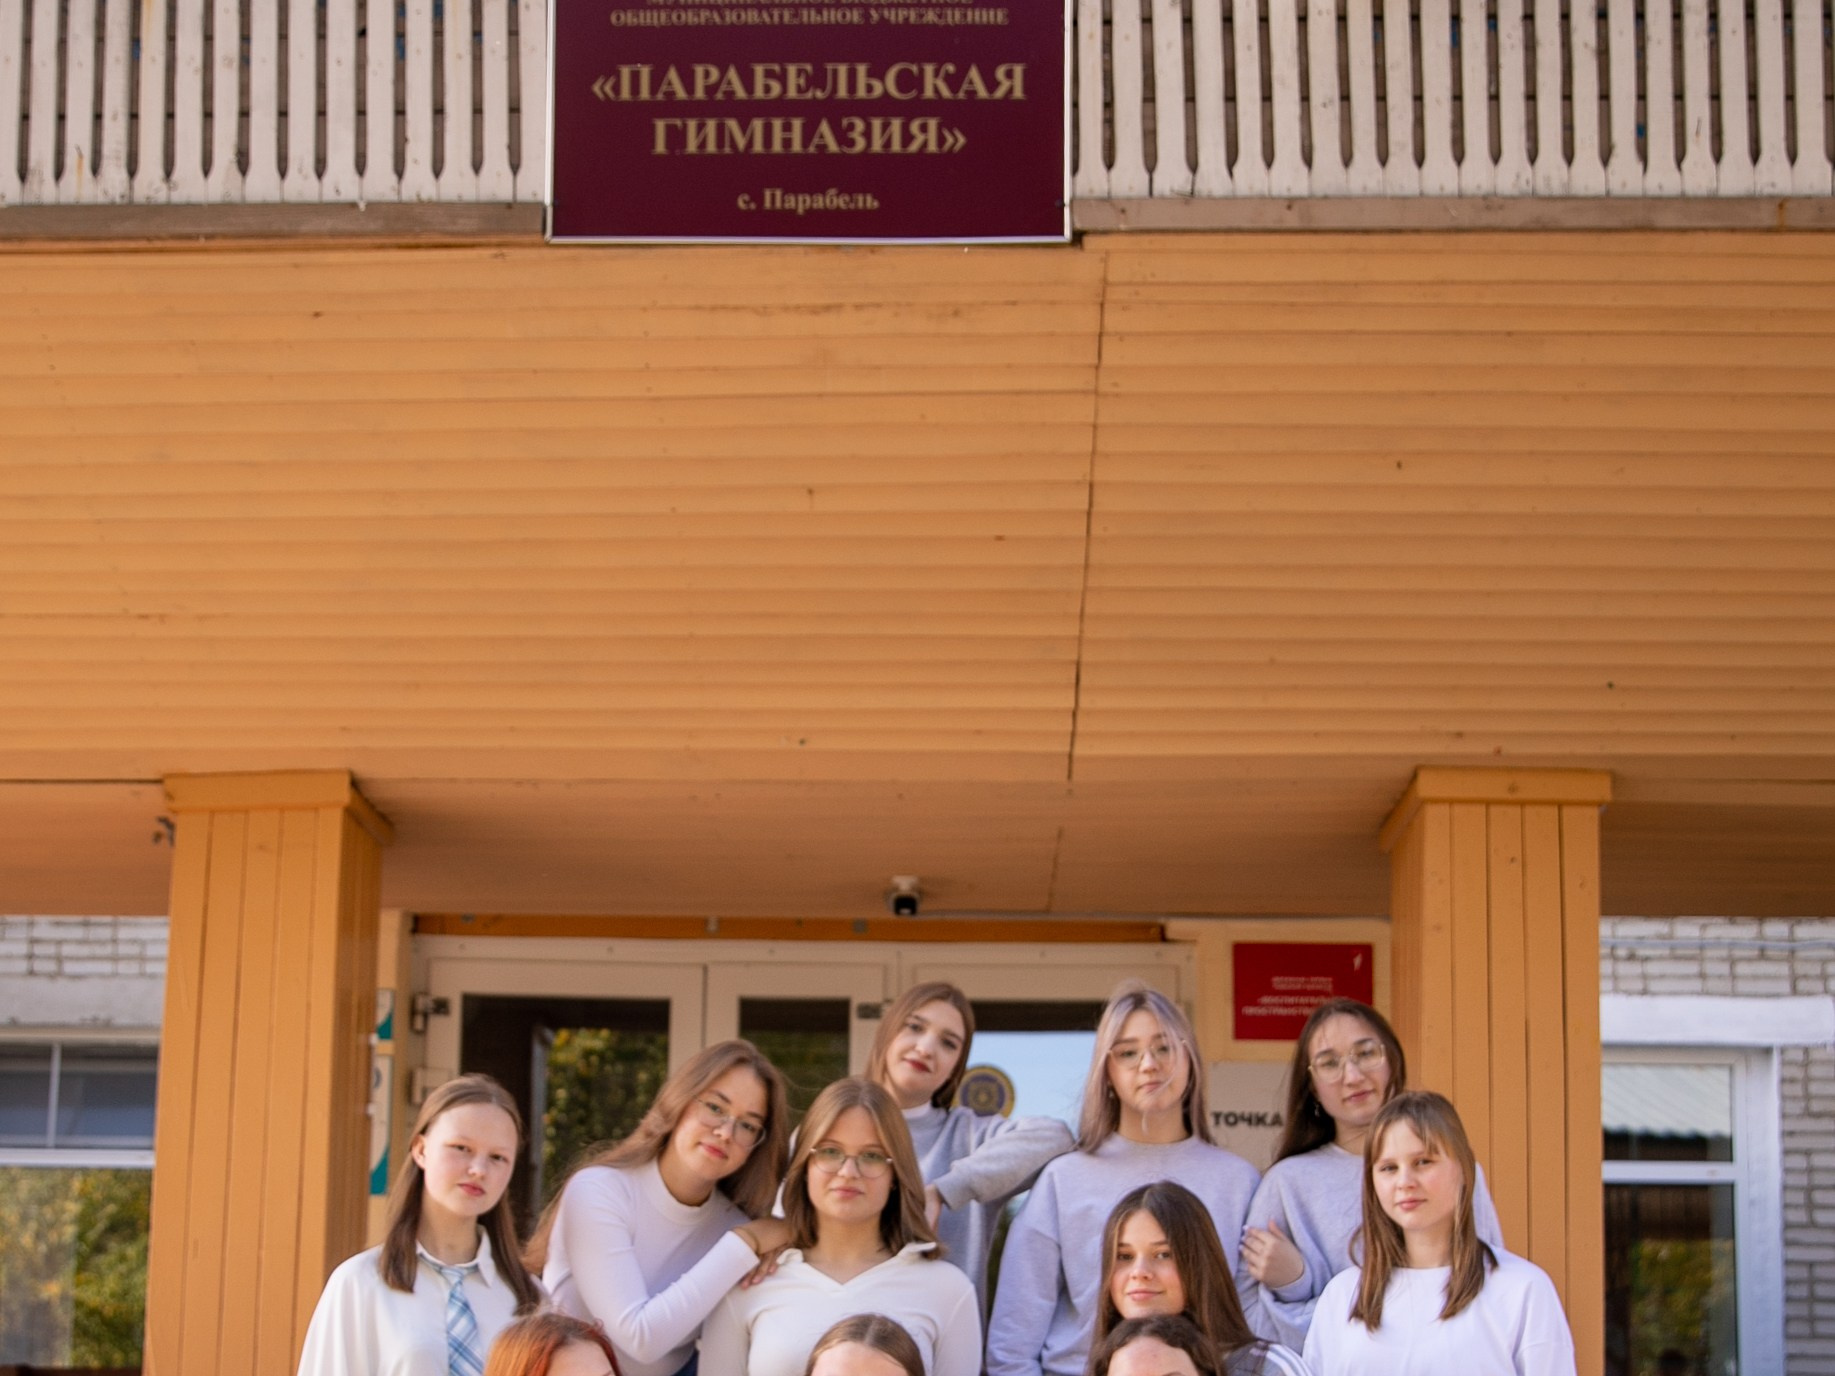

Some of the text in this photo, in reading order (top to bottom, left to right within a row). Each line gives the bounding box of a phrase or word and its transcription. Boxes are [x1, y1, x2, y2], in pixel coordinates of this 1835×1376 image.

[610, 8, 1009, 27] ОБЩЕОБРАЗОВАТЕЛЬНОЕ УЧРЕЖДЕНИЕ
[591, 62, 1027, 101] «ПАРАБЕЛЬСКАЯ
[652, 117, 968, 154] ГИМНАЗИЯ»
[737, 188, 880, 214] с. Парабель
[1211, 1111, 1283, 1127] ТОЧКА
